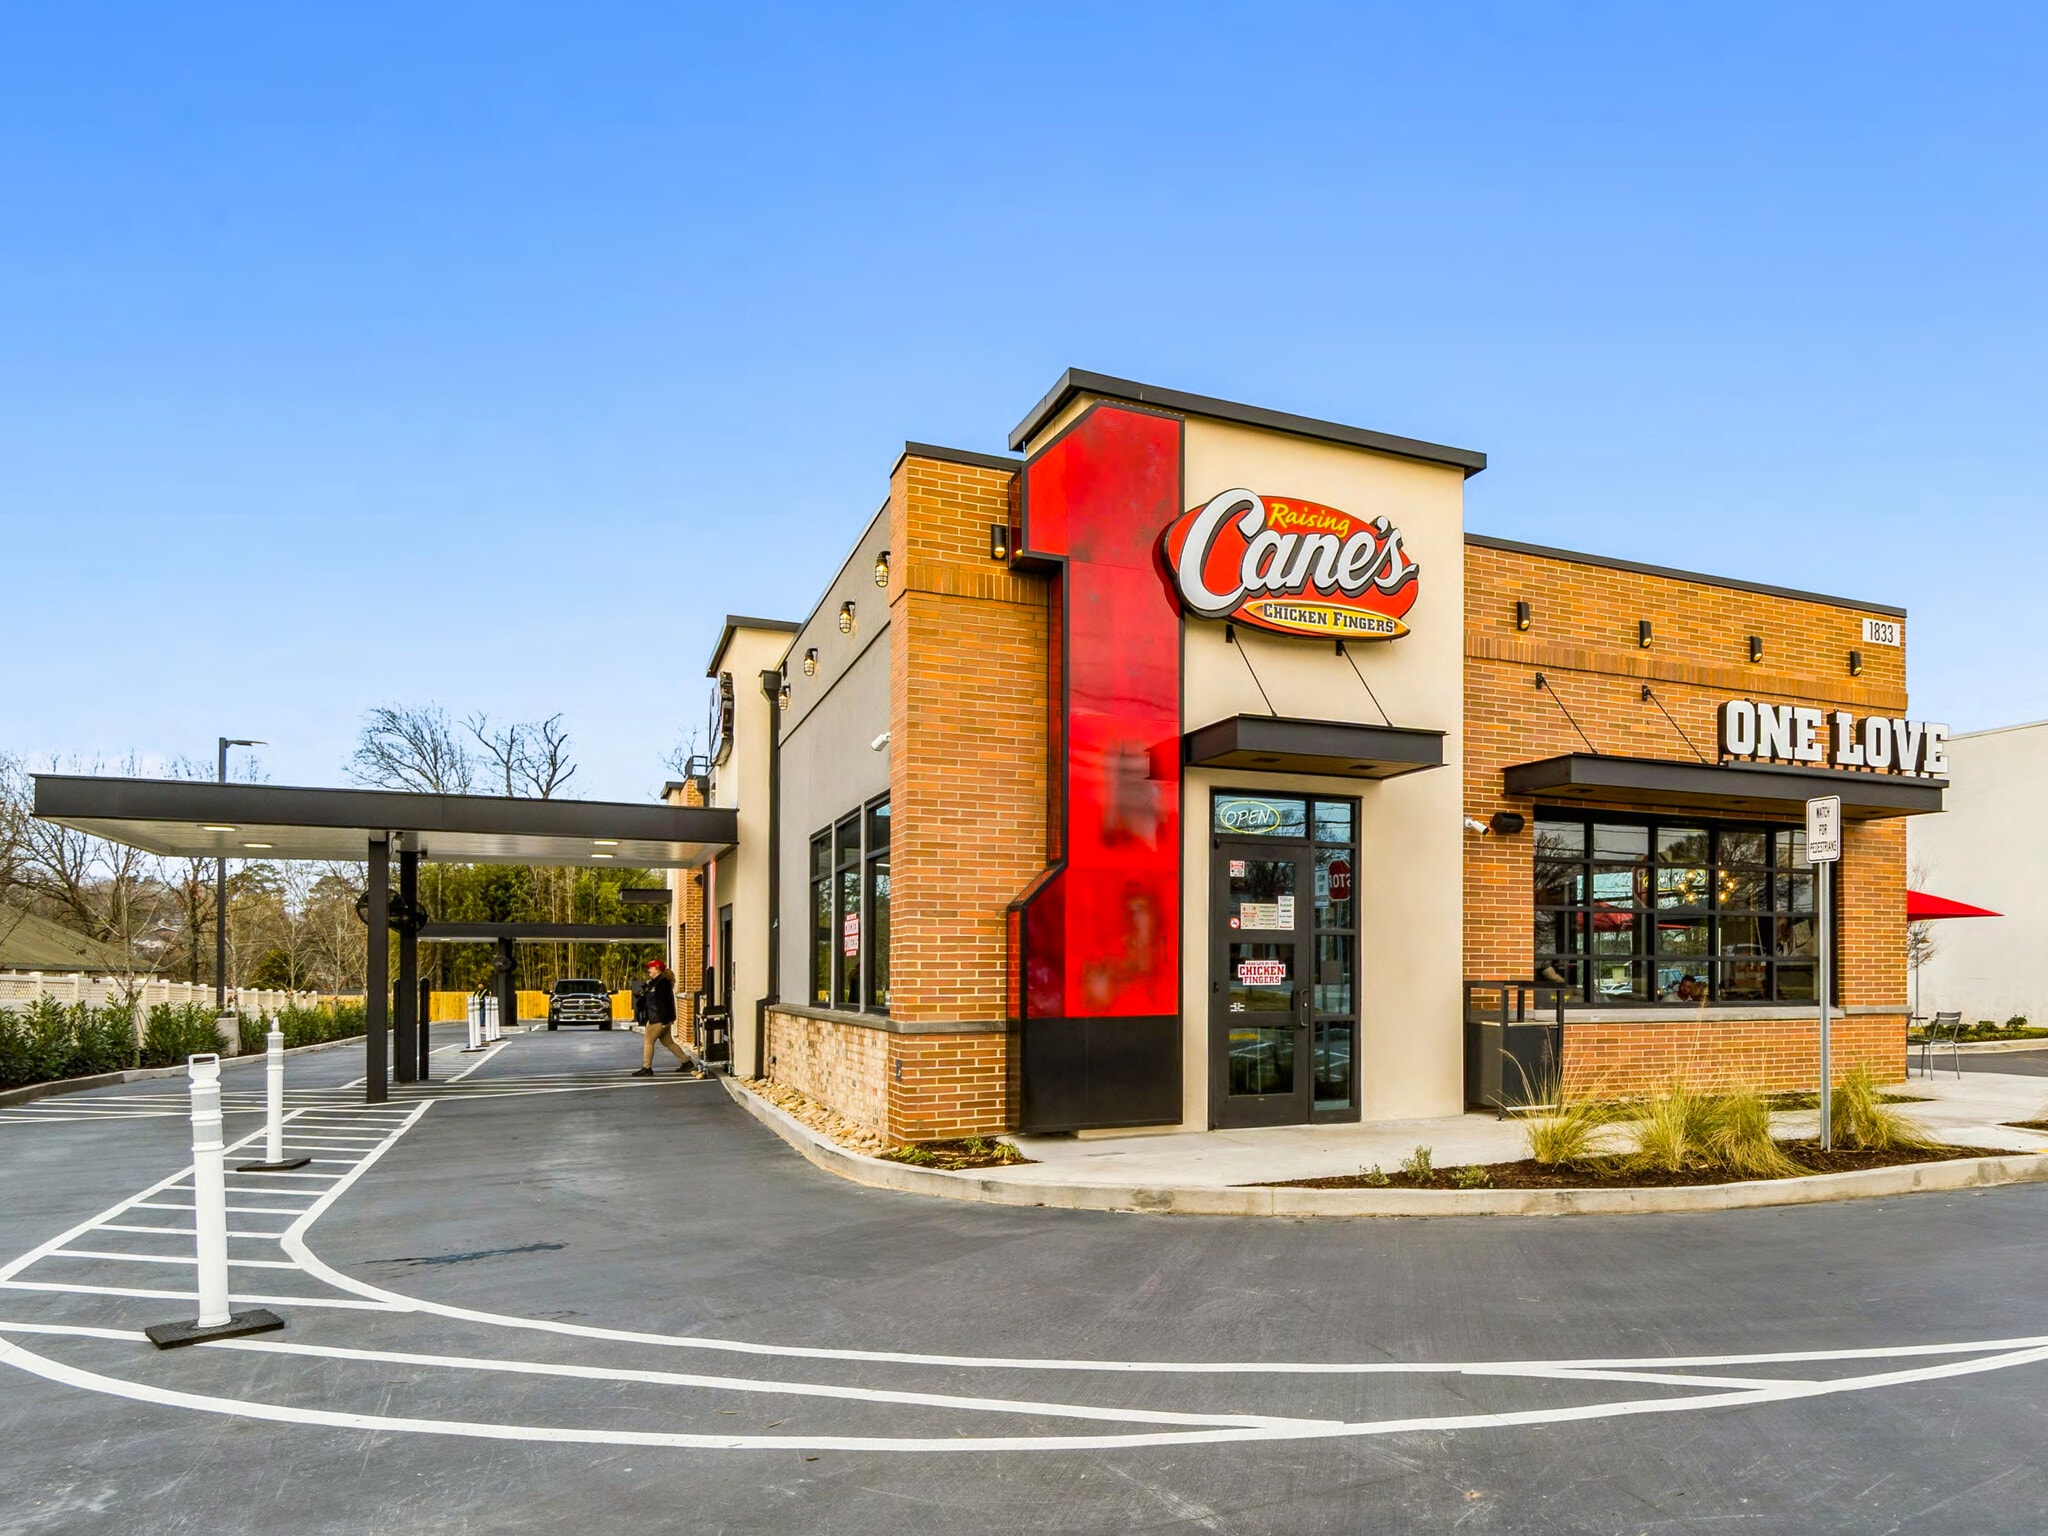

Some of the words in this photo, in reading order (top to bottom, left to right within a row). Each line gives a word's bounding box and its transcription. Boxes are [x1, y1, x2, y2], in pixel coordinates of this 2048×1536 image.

[1268, 503, 1349, 538] Raising
[1178, 488, 1419, 614] Cane's
[1263, 602, 1328, 626] CHICKEN
[1332, 611, 1395, 634] FINGERS
[1869, 621, 1894, 643] 1833
[1722, 699, 1822, 762] ONE
[1832, 711, 1949, 774] LOVE
[1225, 808, 1271, 826] OPEN
[1816, 806, 1831, 818] WATCH
[1239, 965, 1285, 976] CHICKEN
[1243, 976, 1280, 984] FINGERS
